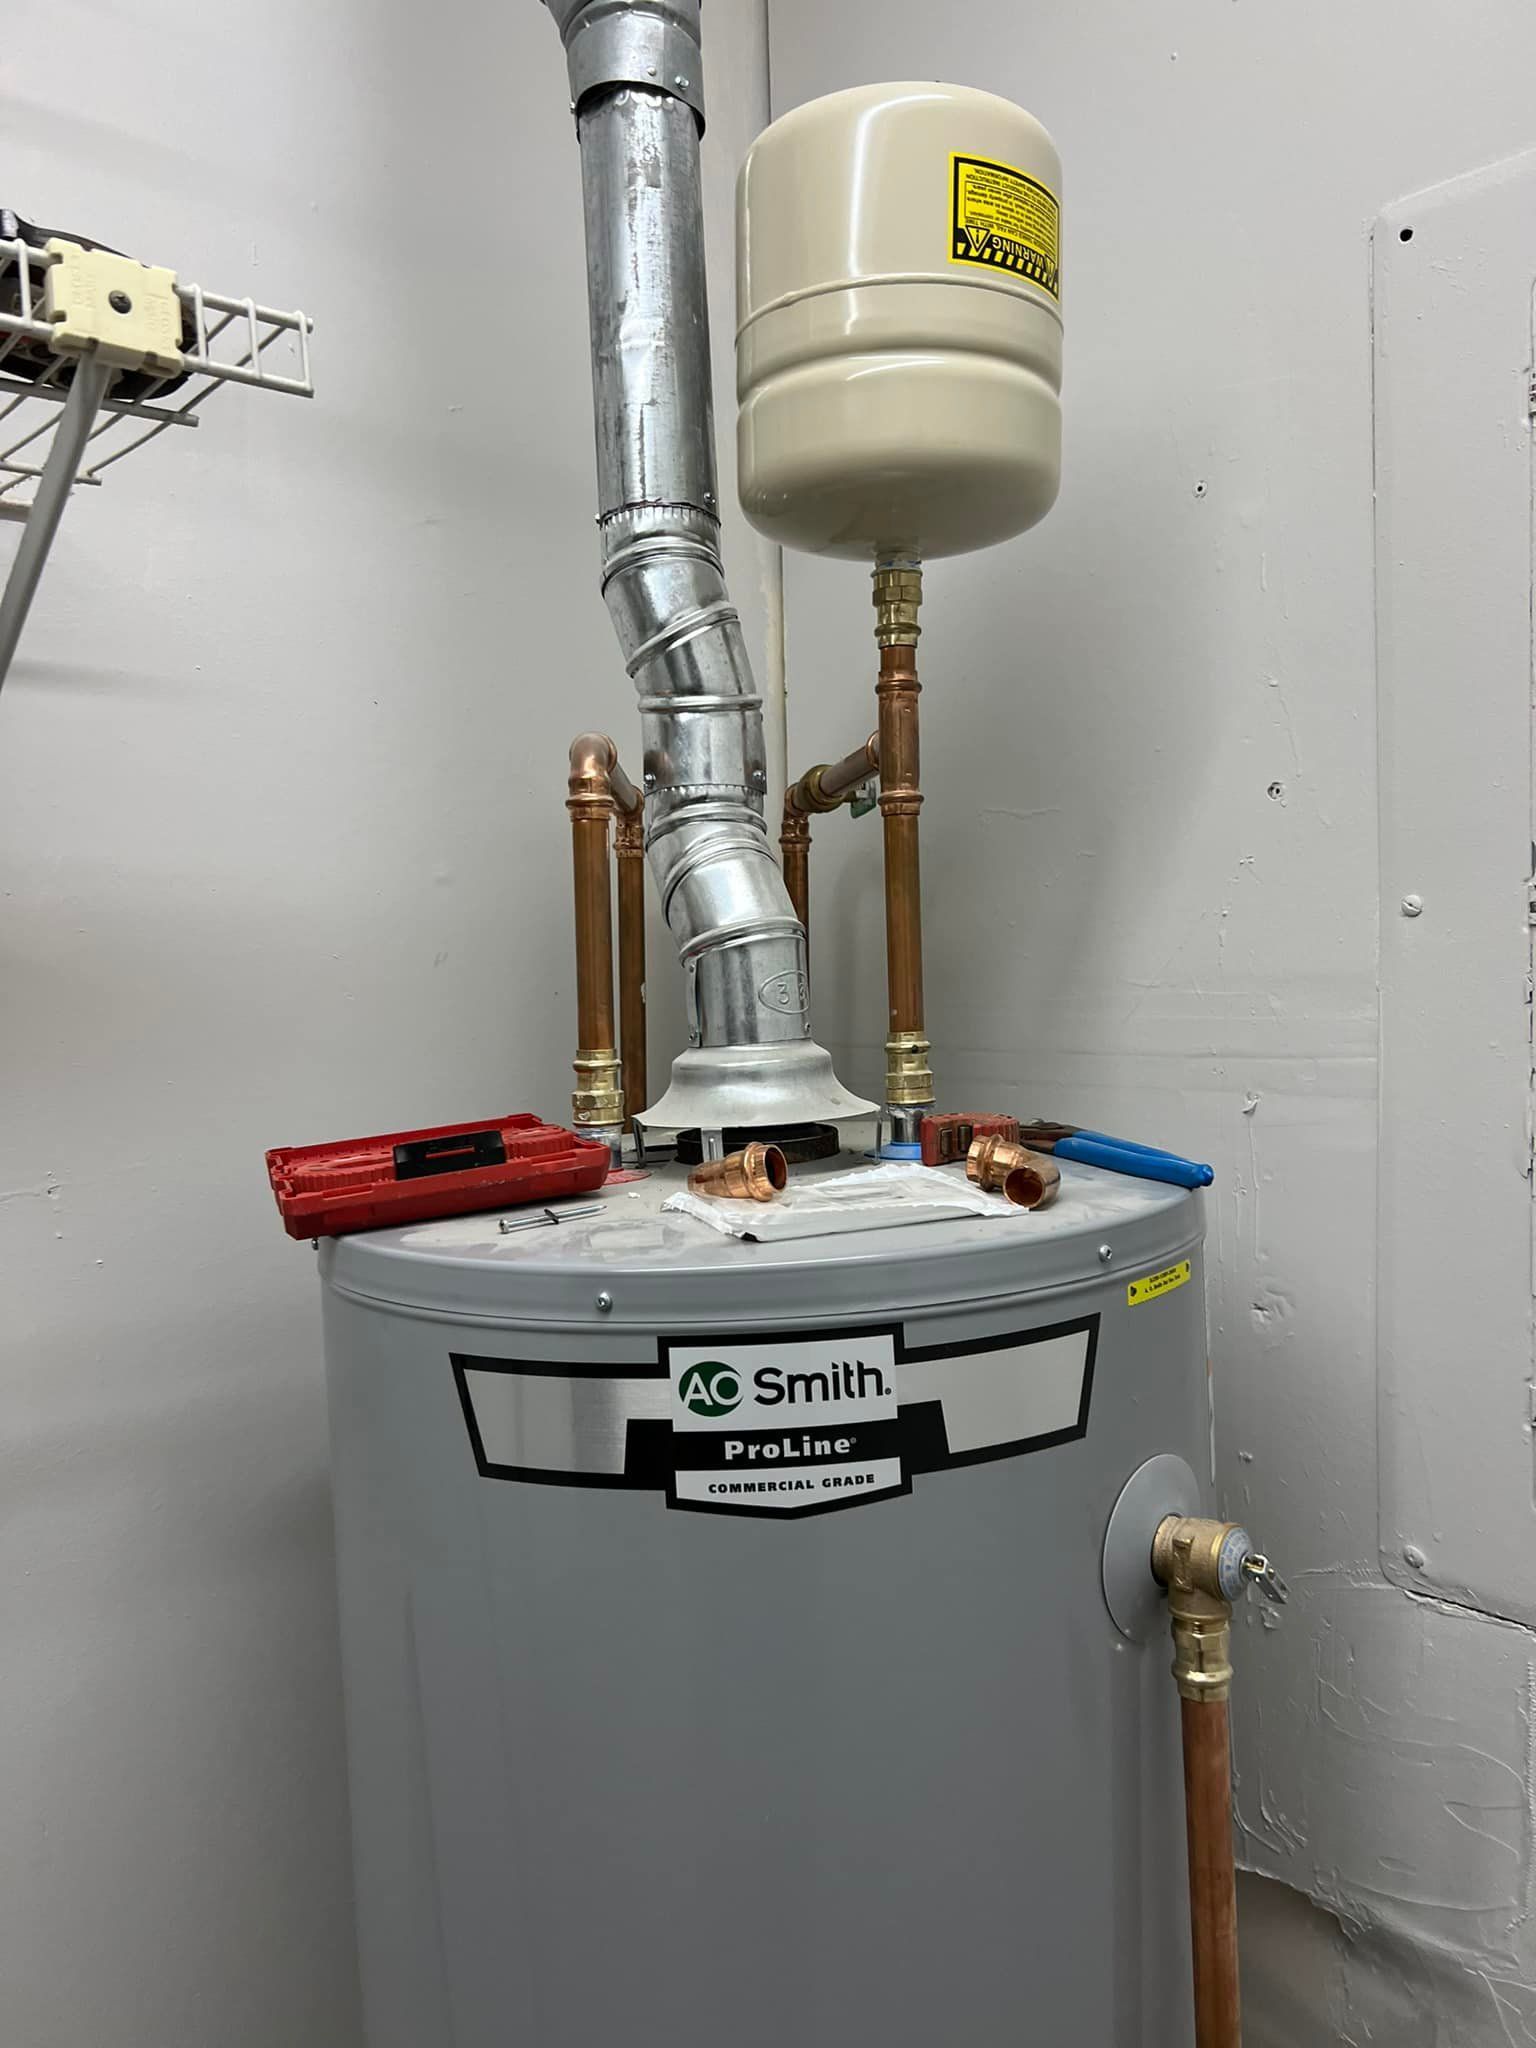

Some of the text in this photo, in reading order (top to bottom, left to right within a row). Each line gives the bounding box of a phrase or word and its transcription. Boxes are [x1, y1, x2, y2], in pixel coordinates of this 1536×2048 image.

[992, 236, 1044, 268] WARNING
[708, 1474, 875, 1494] COMMERCIAL GRADE
